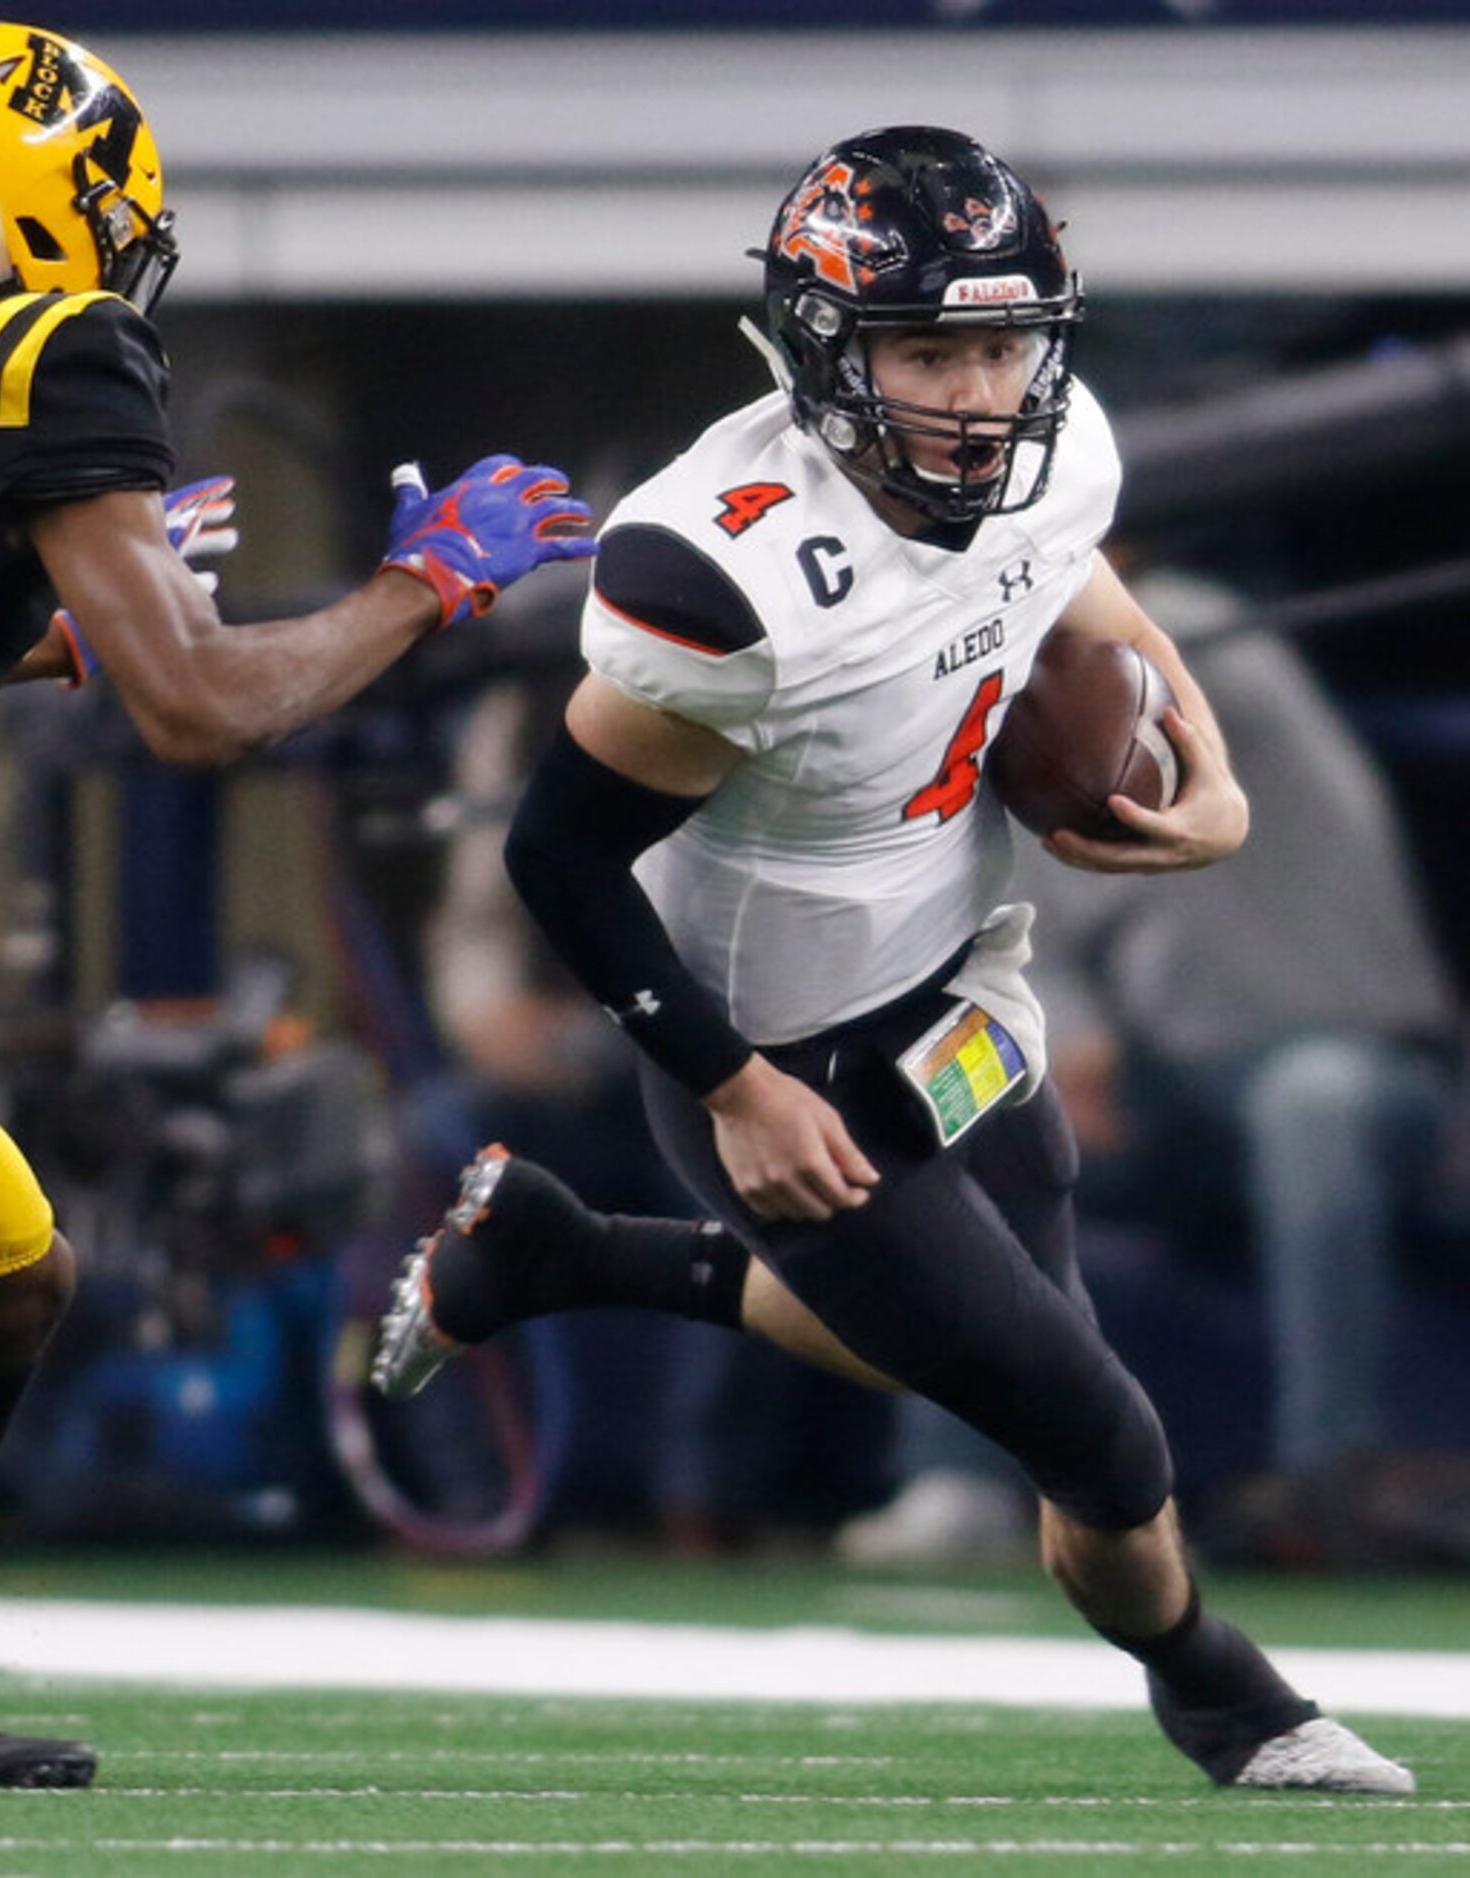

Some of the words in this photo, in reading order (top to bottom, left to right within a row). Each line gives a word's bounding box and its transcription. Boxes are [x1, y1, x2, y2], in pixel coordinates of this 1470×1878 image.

[713, 482, 795, 540] 4
[795, 535, 854, 609] C
[933, 618, 1006, 681] ALEDO
[901, 668, 1003, 826] 4
